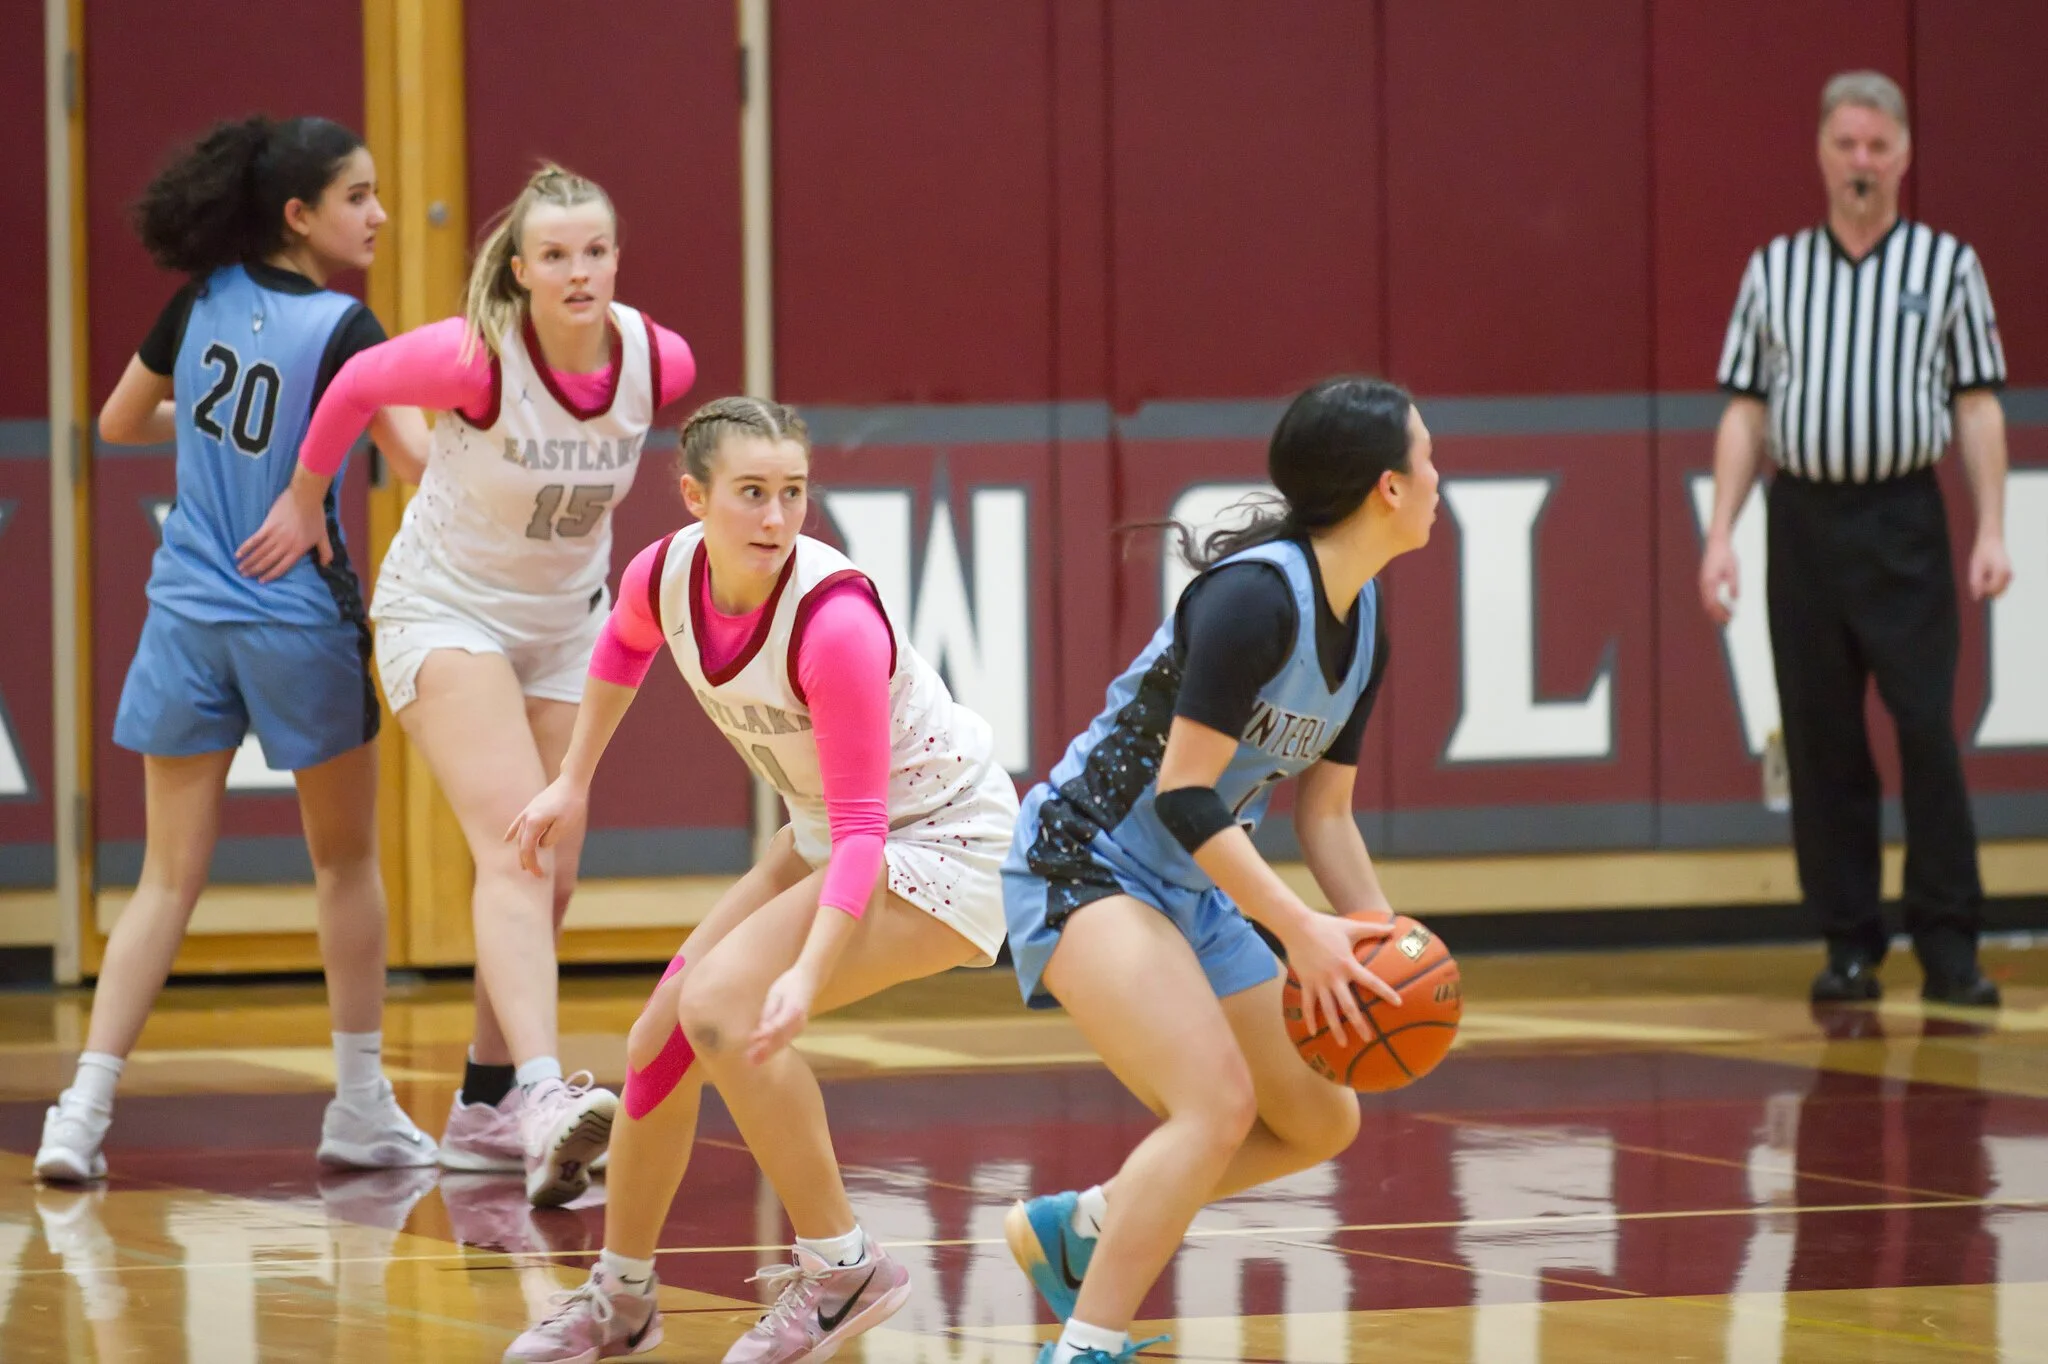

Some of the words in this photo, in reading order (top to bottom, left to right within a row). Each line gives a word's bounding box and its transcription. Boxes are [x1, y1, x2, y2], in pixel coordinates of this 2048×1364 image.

[192, 340, 283, 459] 20
[502, 432, 644, 471] EASTLAK
[525, 484, 615, 541] 15
